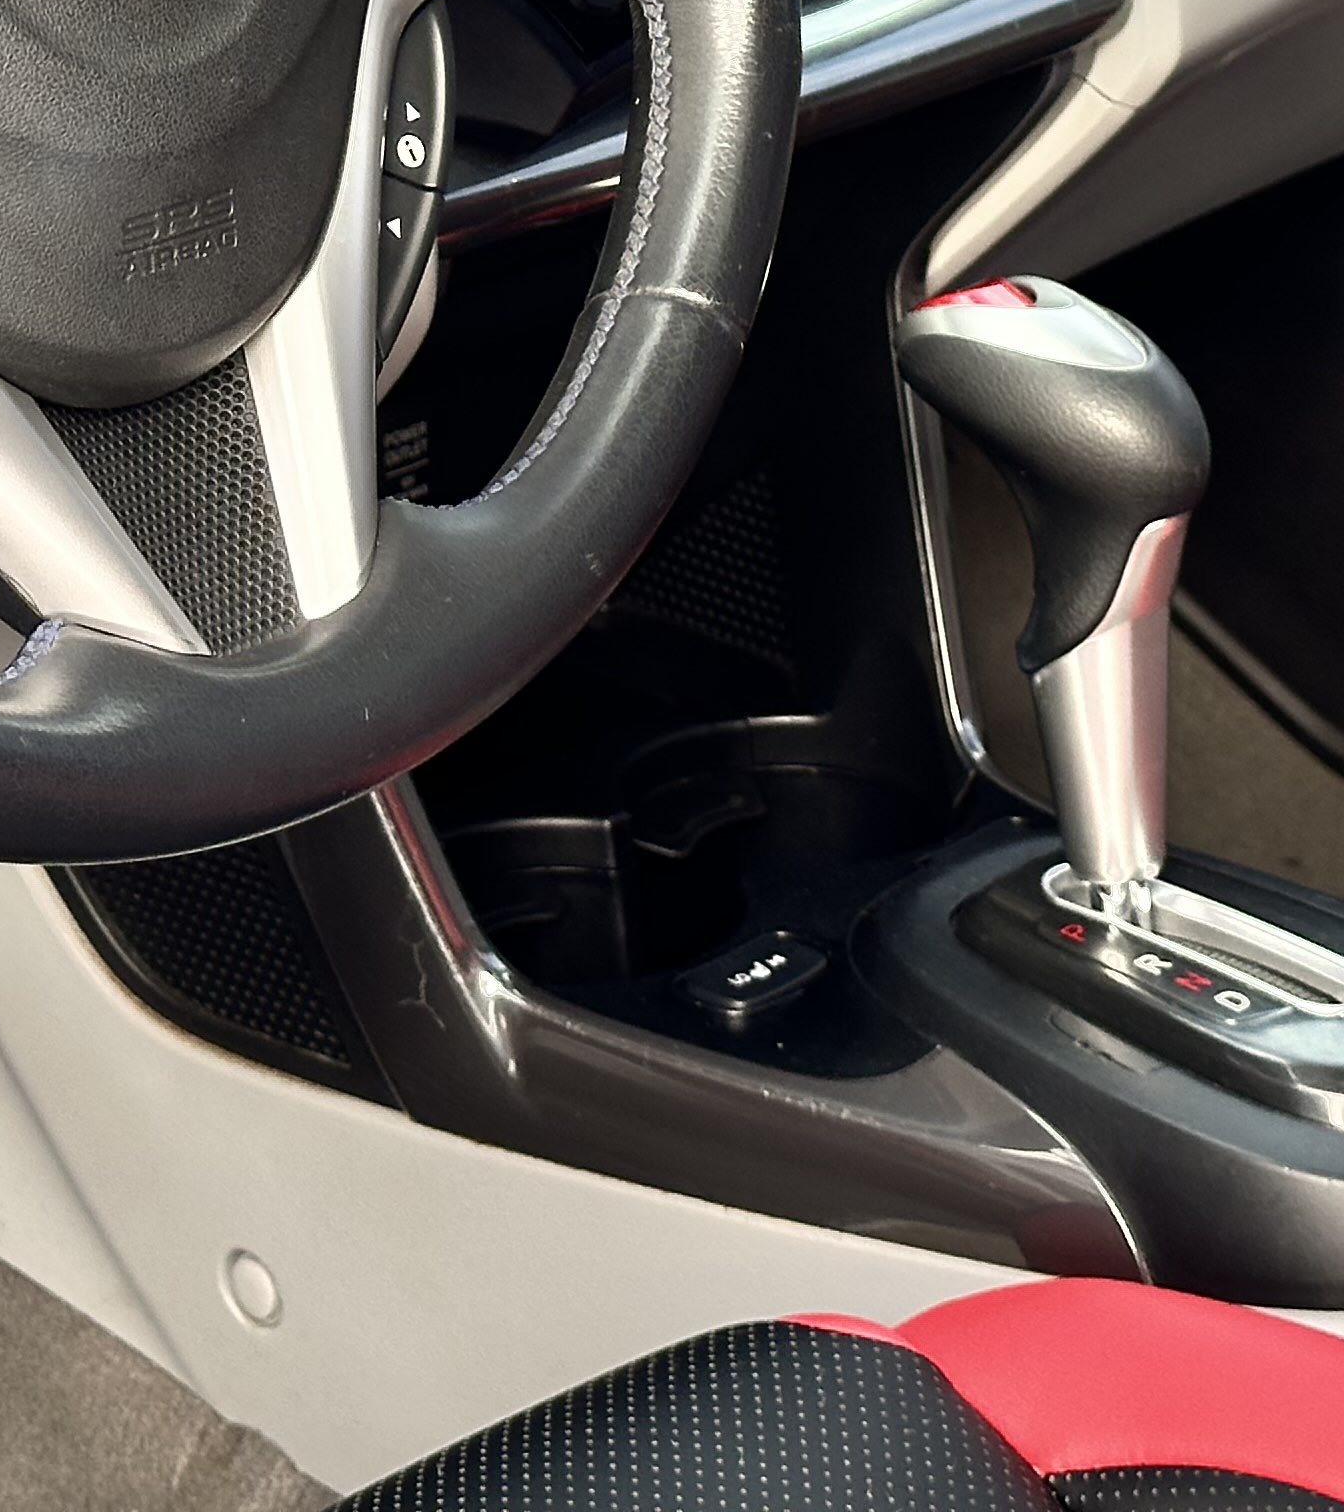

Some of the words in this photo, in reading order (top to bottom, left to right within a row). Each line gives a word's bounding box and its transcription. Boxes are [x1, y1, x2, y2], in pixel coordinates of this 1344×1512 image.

[1059, 922, 1087, 942] P
[1132, 952, 1173, 976] R
[1173, 970, 1213, 993] N
[1213, 989, 1251, 1013] D
